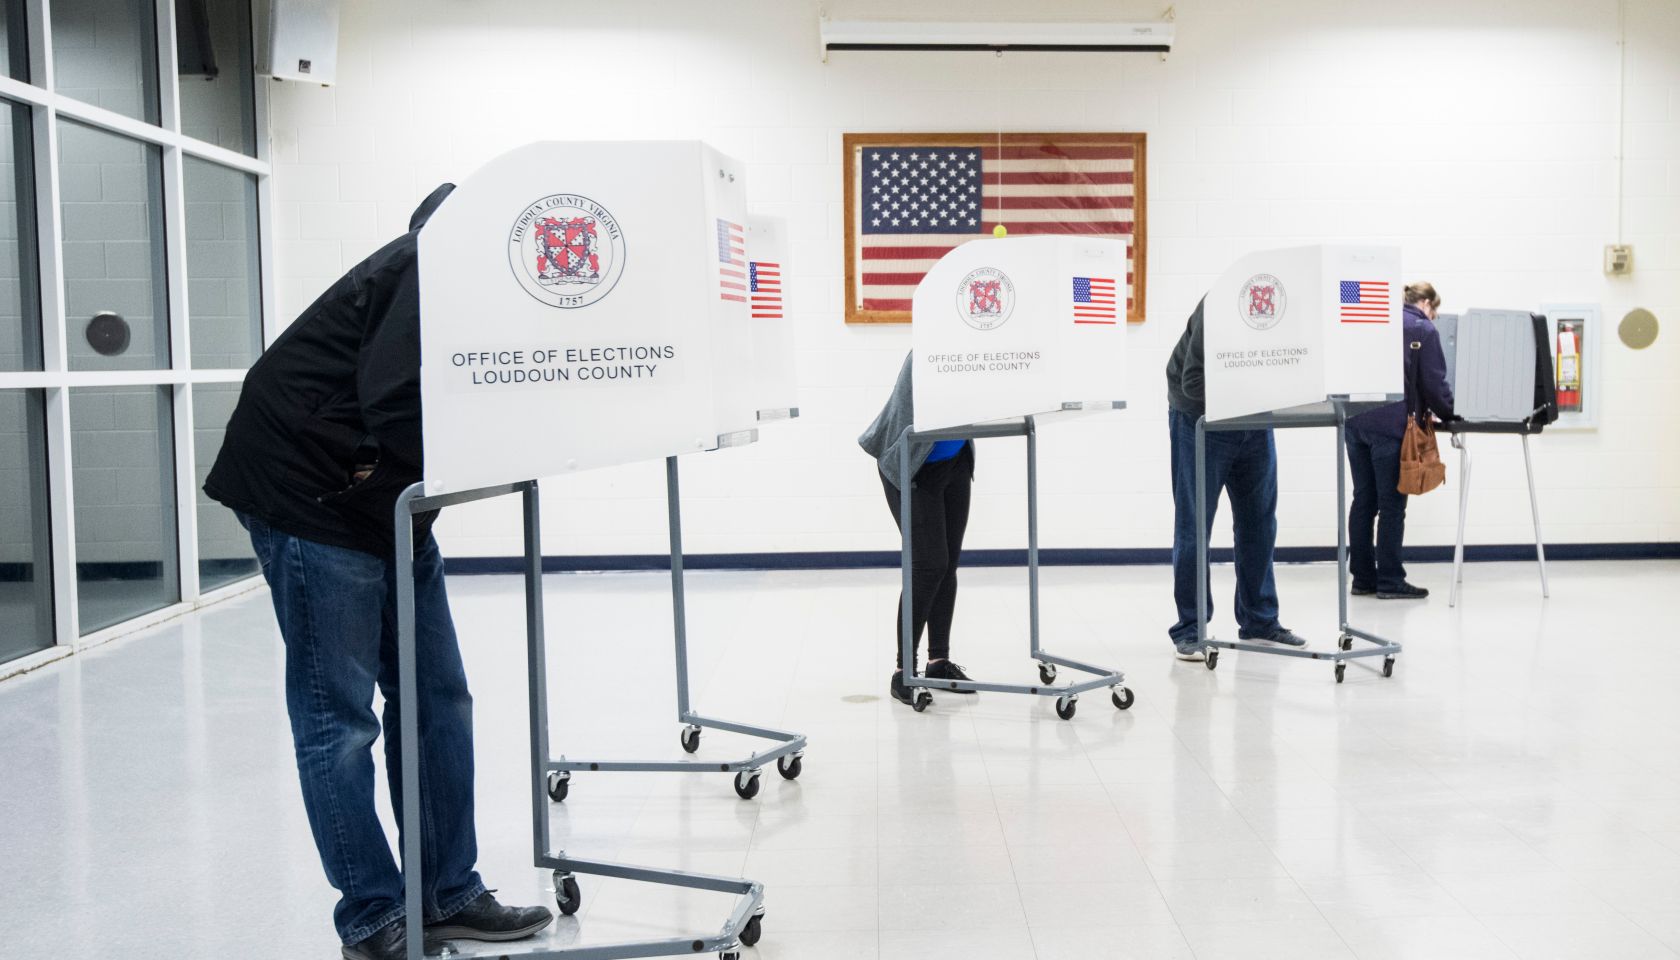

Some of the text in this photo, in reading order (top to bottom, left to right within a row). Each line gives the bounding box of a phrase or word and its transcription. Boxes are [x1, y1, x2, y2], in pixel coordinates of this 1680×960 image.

[512, 196, 619, 243] LOUDOUN COUNTY VIRGINIA
[559, 296, 584, 306] 1757
[452, 345, 675, 367] OFFICE OF ELECTIONS
[928, 351, 1041, 363] OFFICE OF ELECTIONS
[1216, 347, 1308, 360] OFFICE OF ELECTIONS
[937, 361, 1031, 373] LOUDOUN COUNTY
[1224, 357, 1300, 369] LOUDOUN COUNTY
[472, 364, 658, 385] LOUDOUN COUNTY
